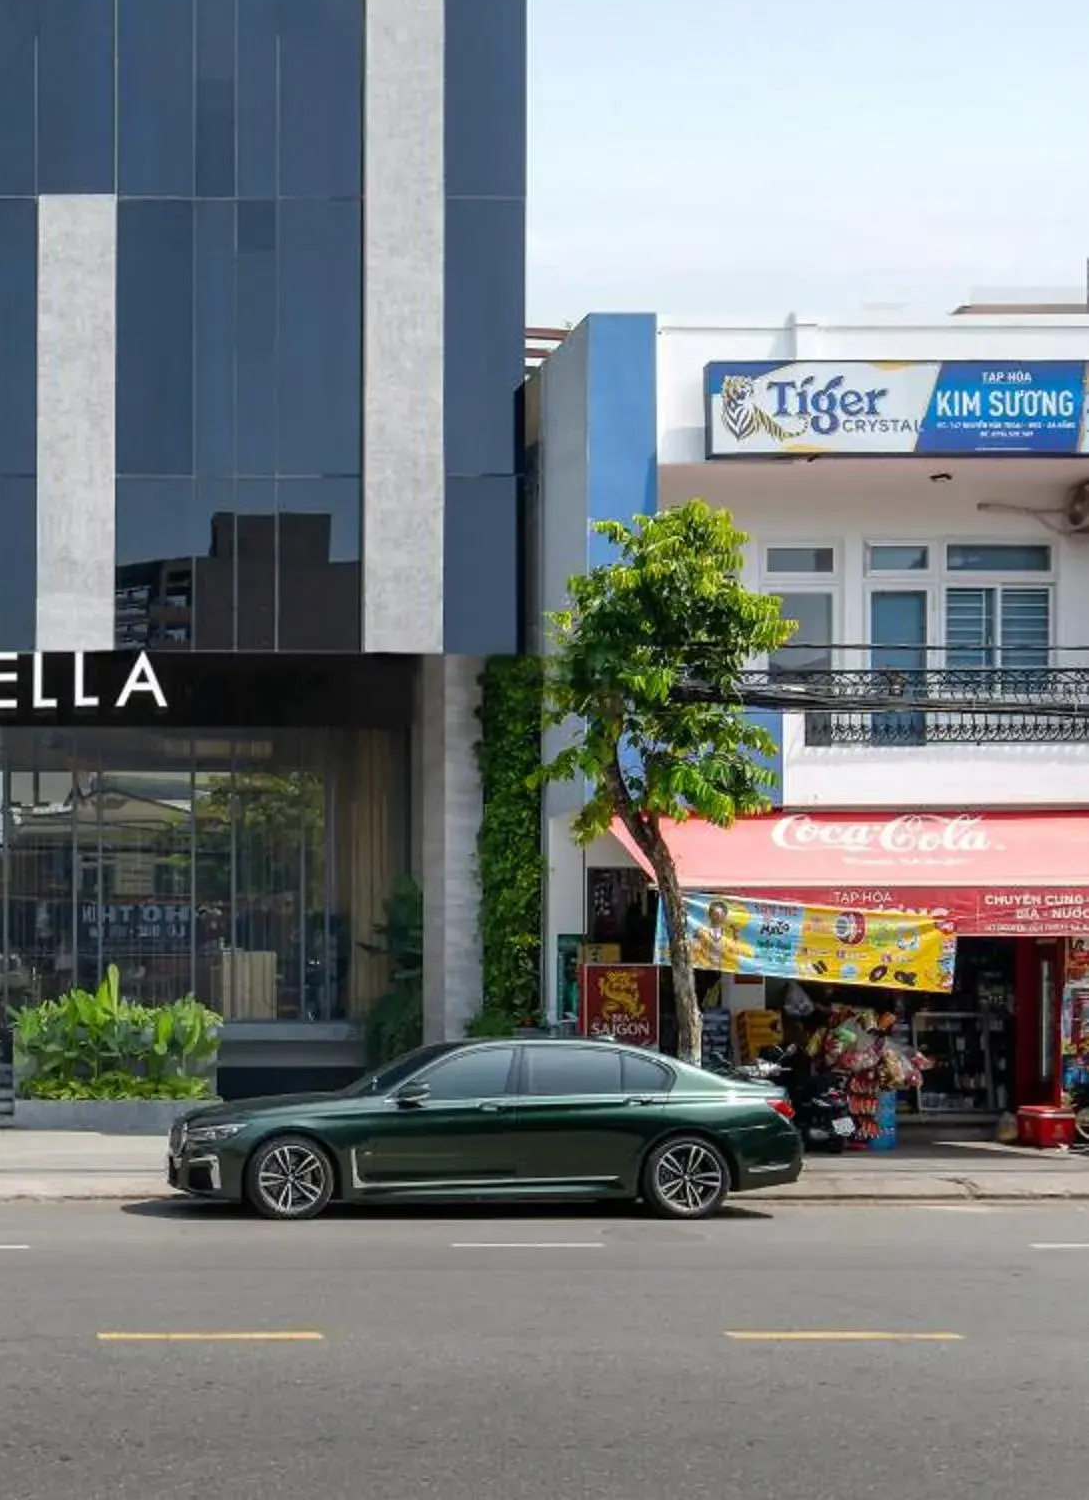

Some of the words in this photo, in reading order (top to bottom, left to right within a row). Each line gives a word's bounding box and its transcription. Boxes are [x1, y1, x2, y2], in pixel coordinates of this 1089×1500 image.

[766, 375, 889, 435] Tiger
[936, 390, 982, 417] KIM
[988, 389, 1075, 417] SƯƠNG
[842, 419, 923, 433] CRYSTAL
